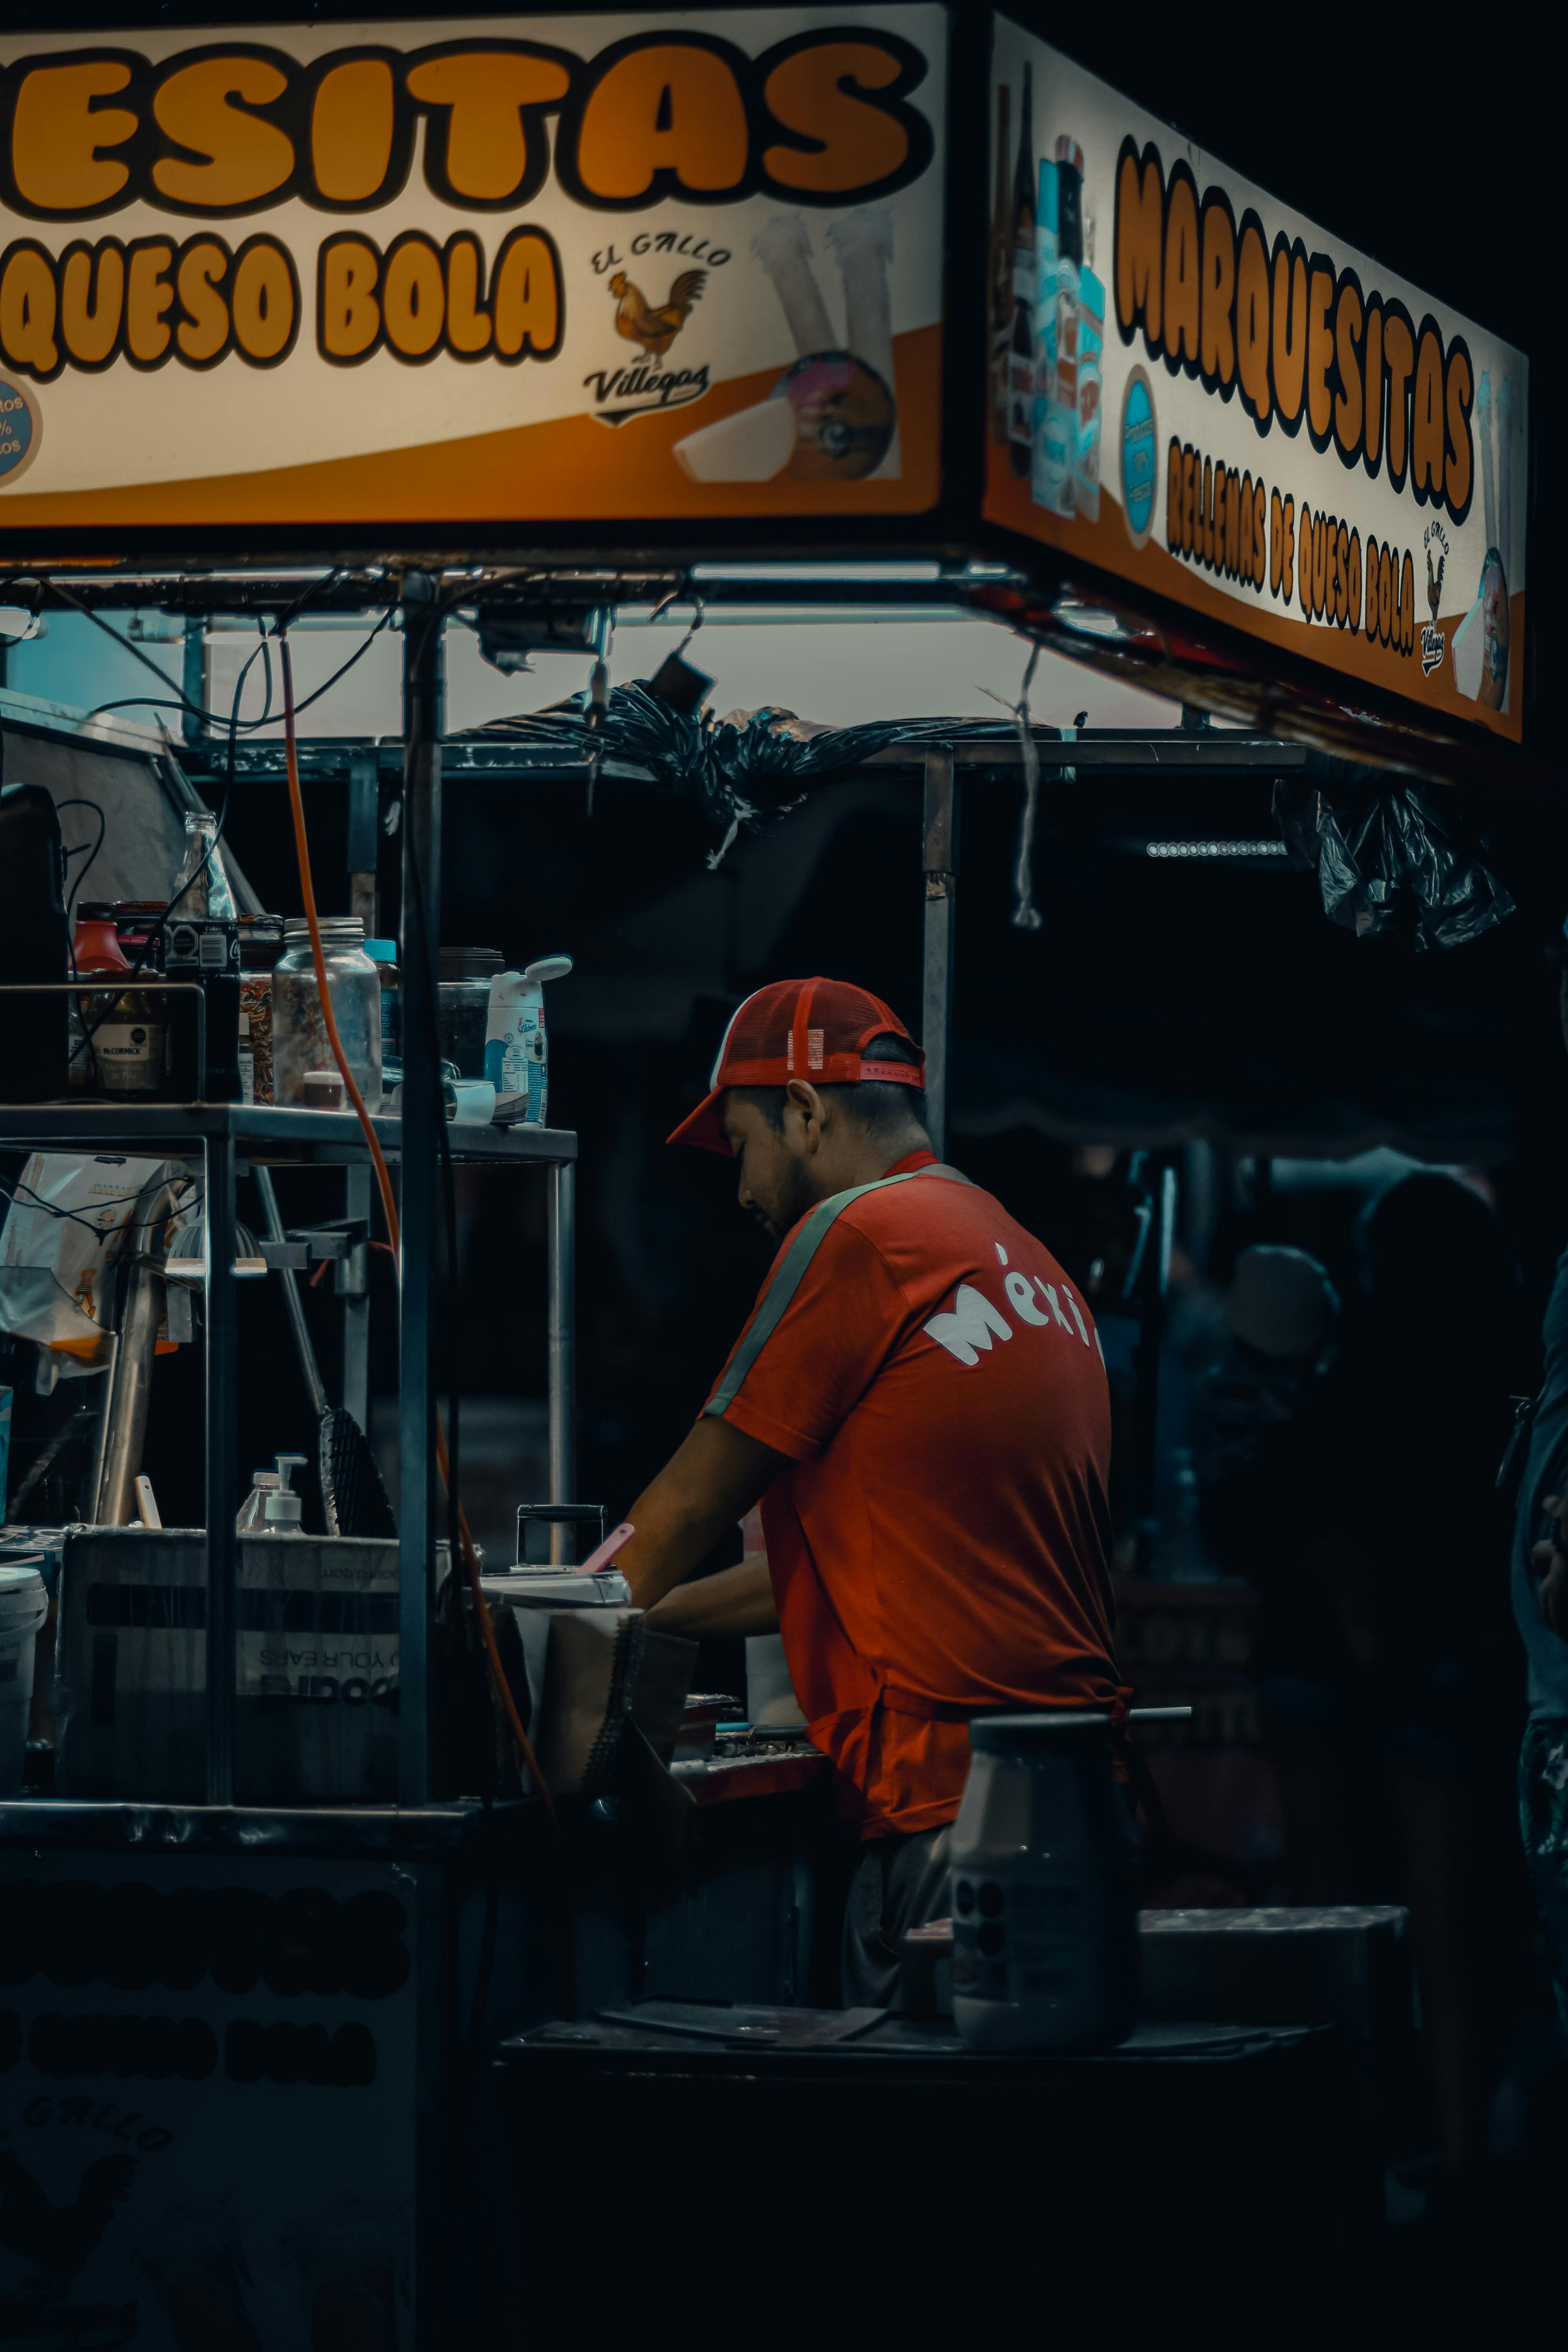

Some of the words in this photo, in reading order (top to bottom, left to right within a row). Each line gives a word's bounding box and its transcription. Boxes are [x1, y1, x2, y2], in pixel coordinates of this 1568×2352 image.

[0, 27, 935, 223] ESITAS
[591, 245, 623, 274] EL
[631, 231, 731, 267] GALLO
[0, 230, 302, 384] QUESO
[316, 225, 565, 369] BOLA
[1114, 133, 1475, 526] MARQUESITAS
[583, 365, 710, 405] Villegas
[1167, 436, 1266, 593] RELLENAS
[1270, 486, 1294, 606] DE
[1298, 502, 1362, 635] QUESO
[1365, 534, 1414, 657] BOLA
[1424, 526, 1430, 549] EL
[1431, 521, 1449, 555] GALLO
[1421, 629, 1445, 661] Villegas
[923, 1241, 1106, 1367] Méxi
[260, 1650, 317, 1667] EARS
[323, 1651, 385, 1668] YOUR
[23, 2096, 172, 2152] GALLO
